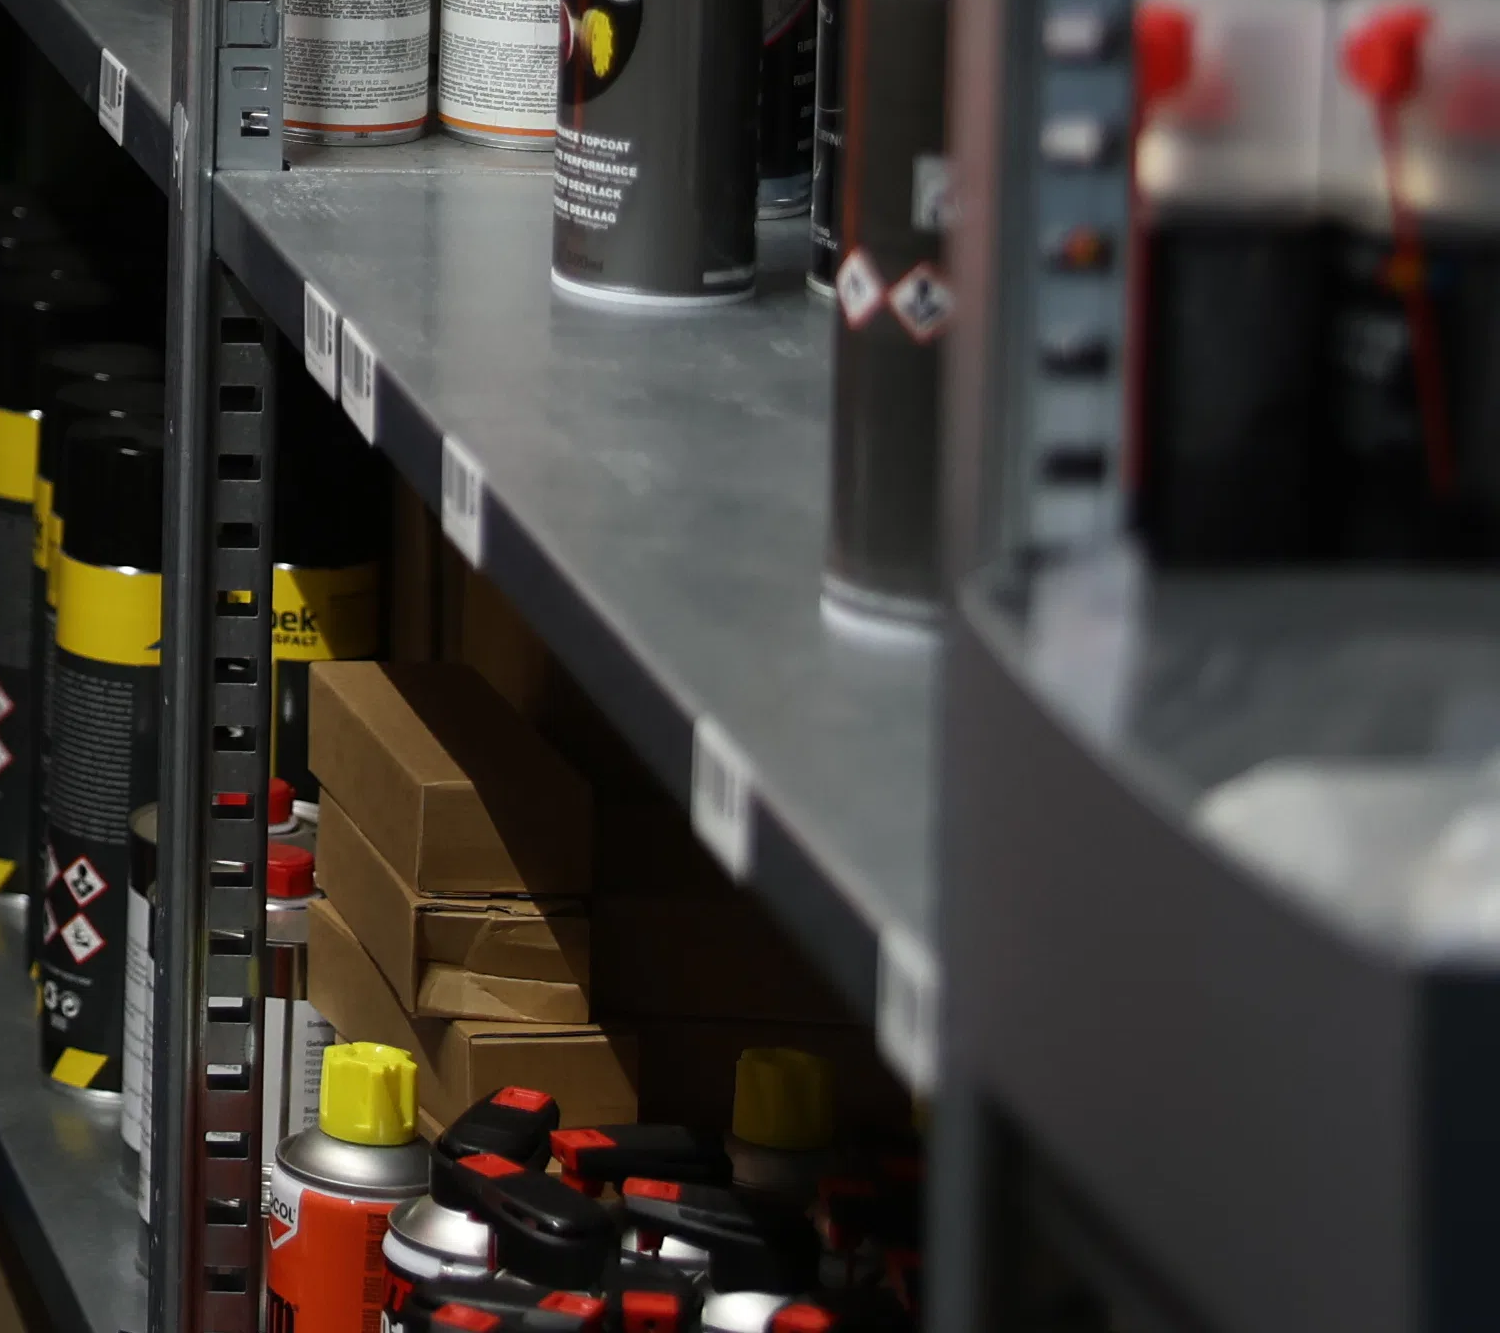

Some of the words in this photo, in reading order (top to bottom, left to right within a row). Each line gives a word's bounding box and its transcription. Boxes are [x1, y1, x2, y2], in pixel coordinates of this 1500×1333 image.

[581, 134, 631, 153] TOPCOAT
[564, 153, 638, 178] PERFORMANCE
[569, 178, 622, 200] DECKLACK
[569, 202, 617, 224] DEKLAAG
